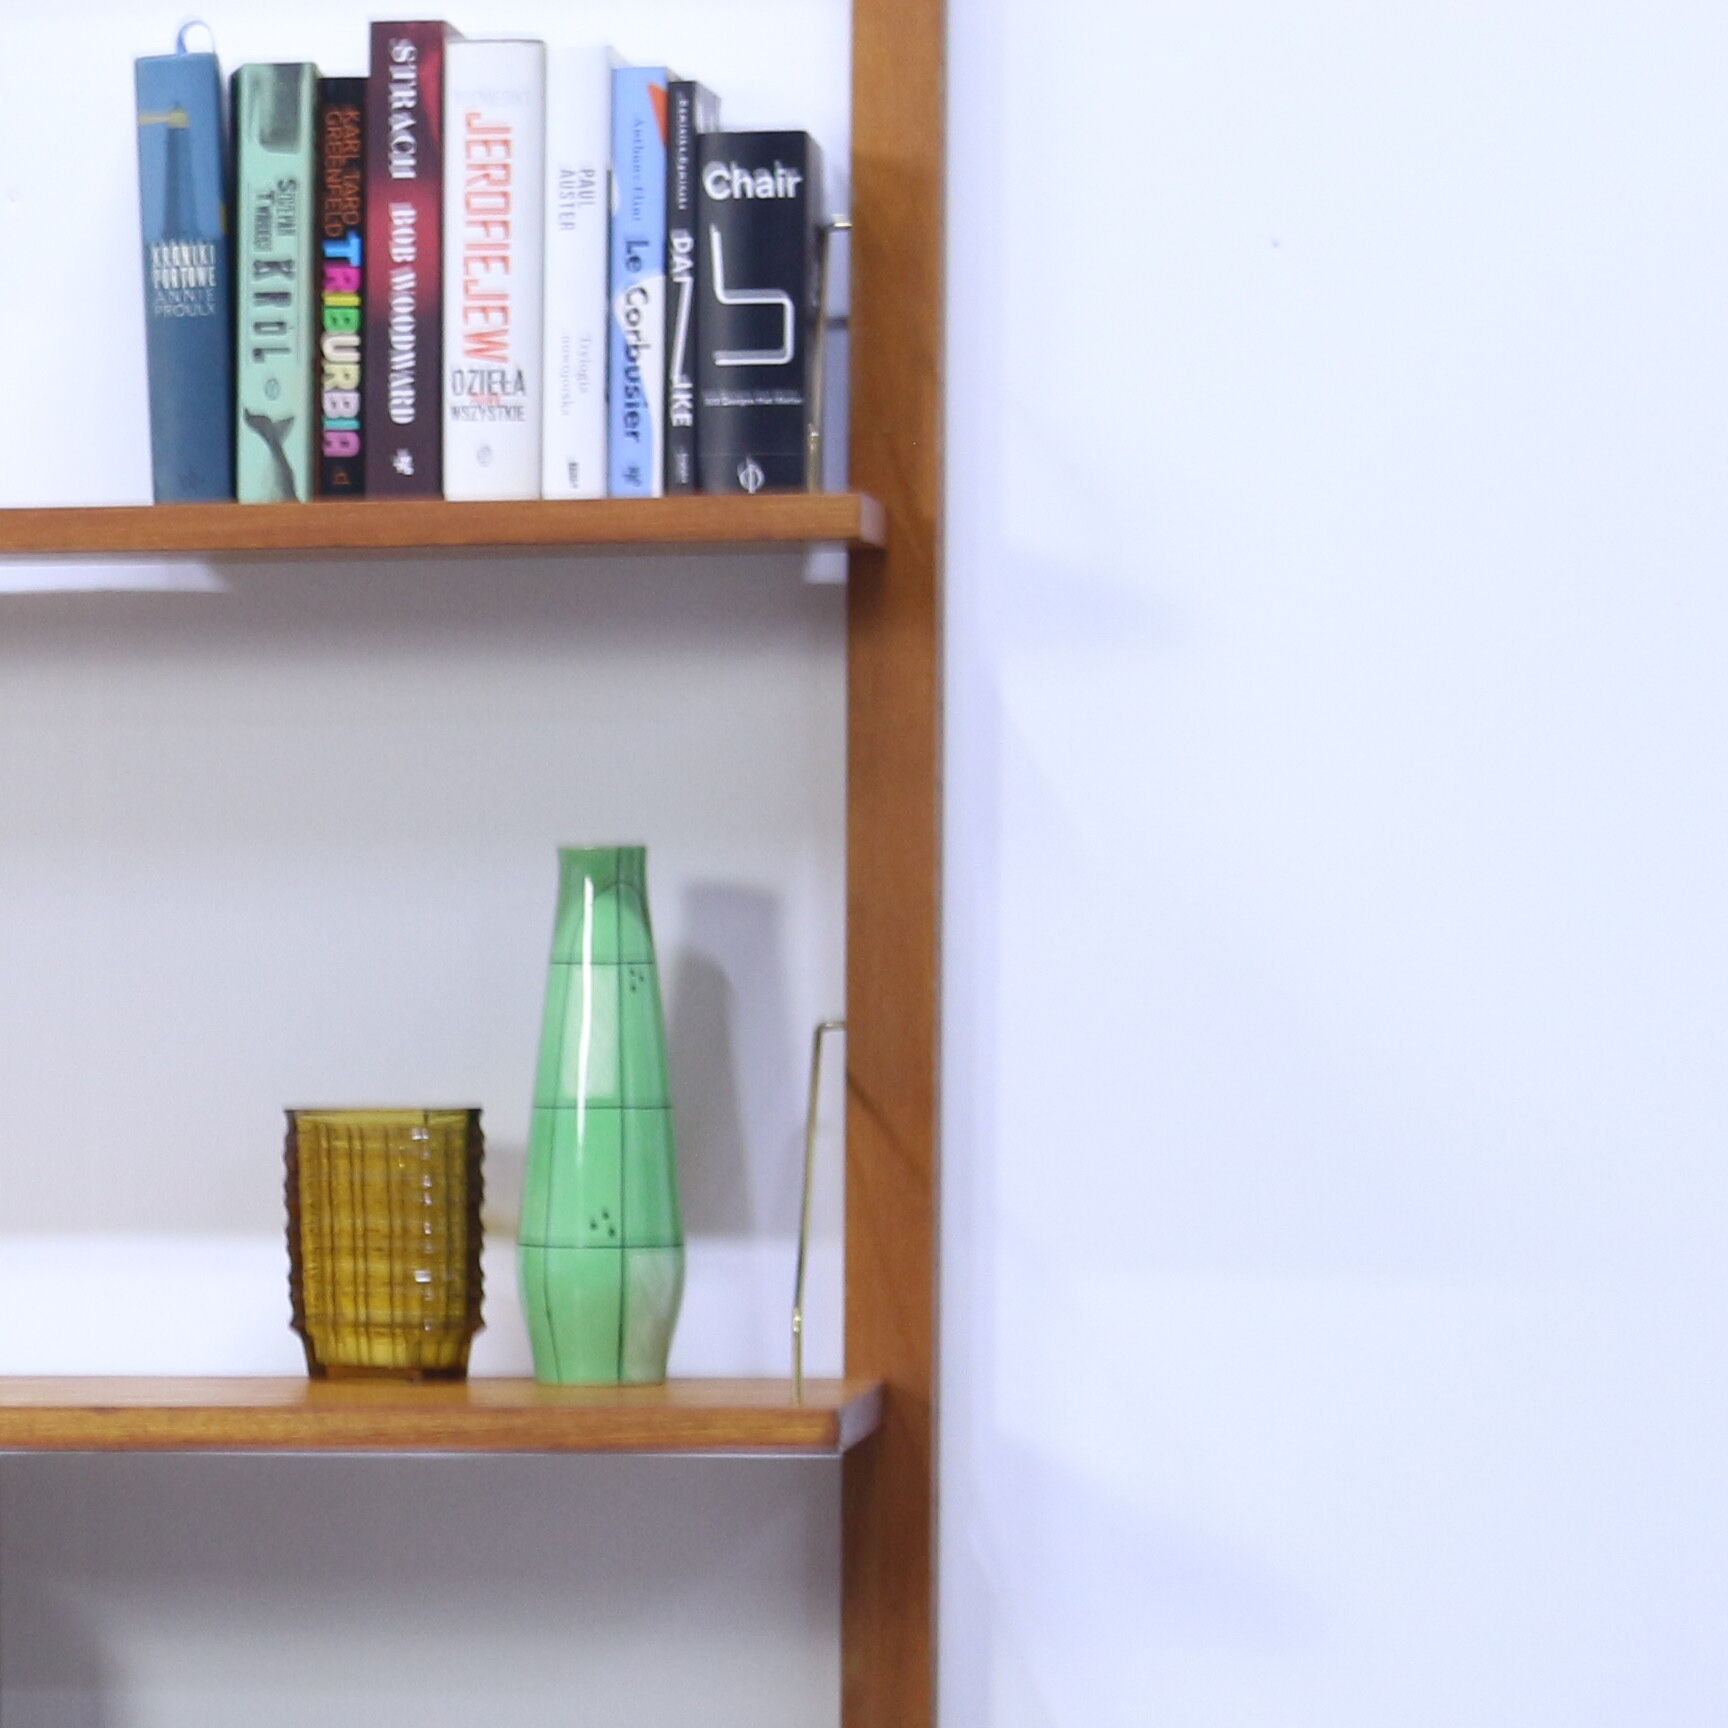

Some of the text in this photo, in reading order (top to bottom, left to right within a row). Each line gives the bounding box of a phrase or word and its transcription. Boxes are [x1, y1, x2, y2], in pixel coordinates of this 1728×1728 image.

[343, 104, 362, 226] KARL TARO
[389, 38, 417, 179] STRACH
[324, 111, 344, 238] GREENFELD
[463, 110, 513, 364] JEROFIEJEW
[558, 168, 576, 231] AUSTER
[576, 167, 596, 206] PAUL
[702, 160, 803, 201] Chair
[320, 229, 363, 459] TRIBURBIA
[388, 202, 417, 424] BOB WOODWARD
[623, 239, 651, 443] Le Corbusier
[450, 405, 526, 422] WSZYSTKIE
